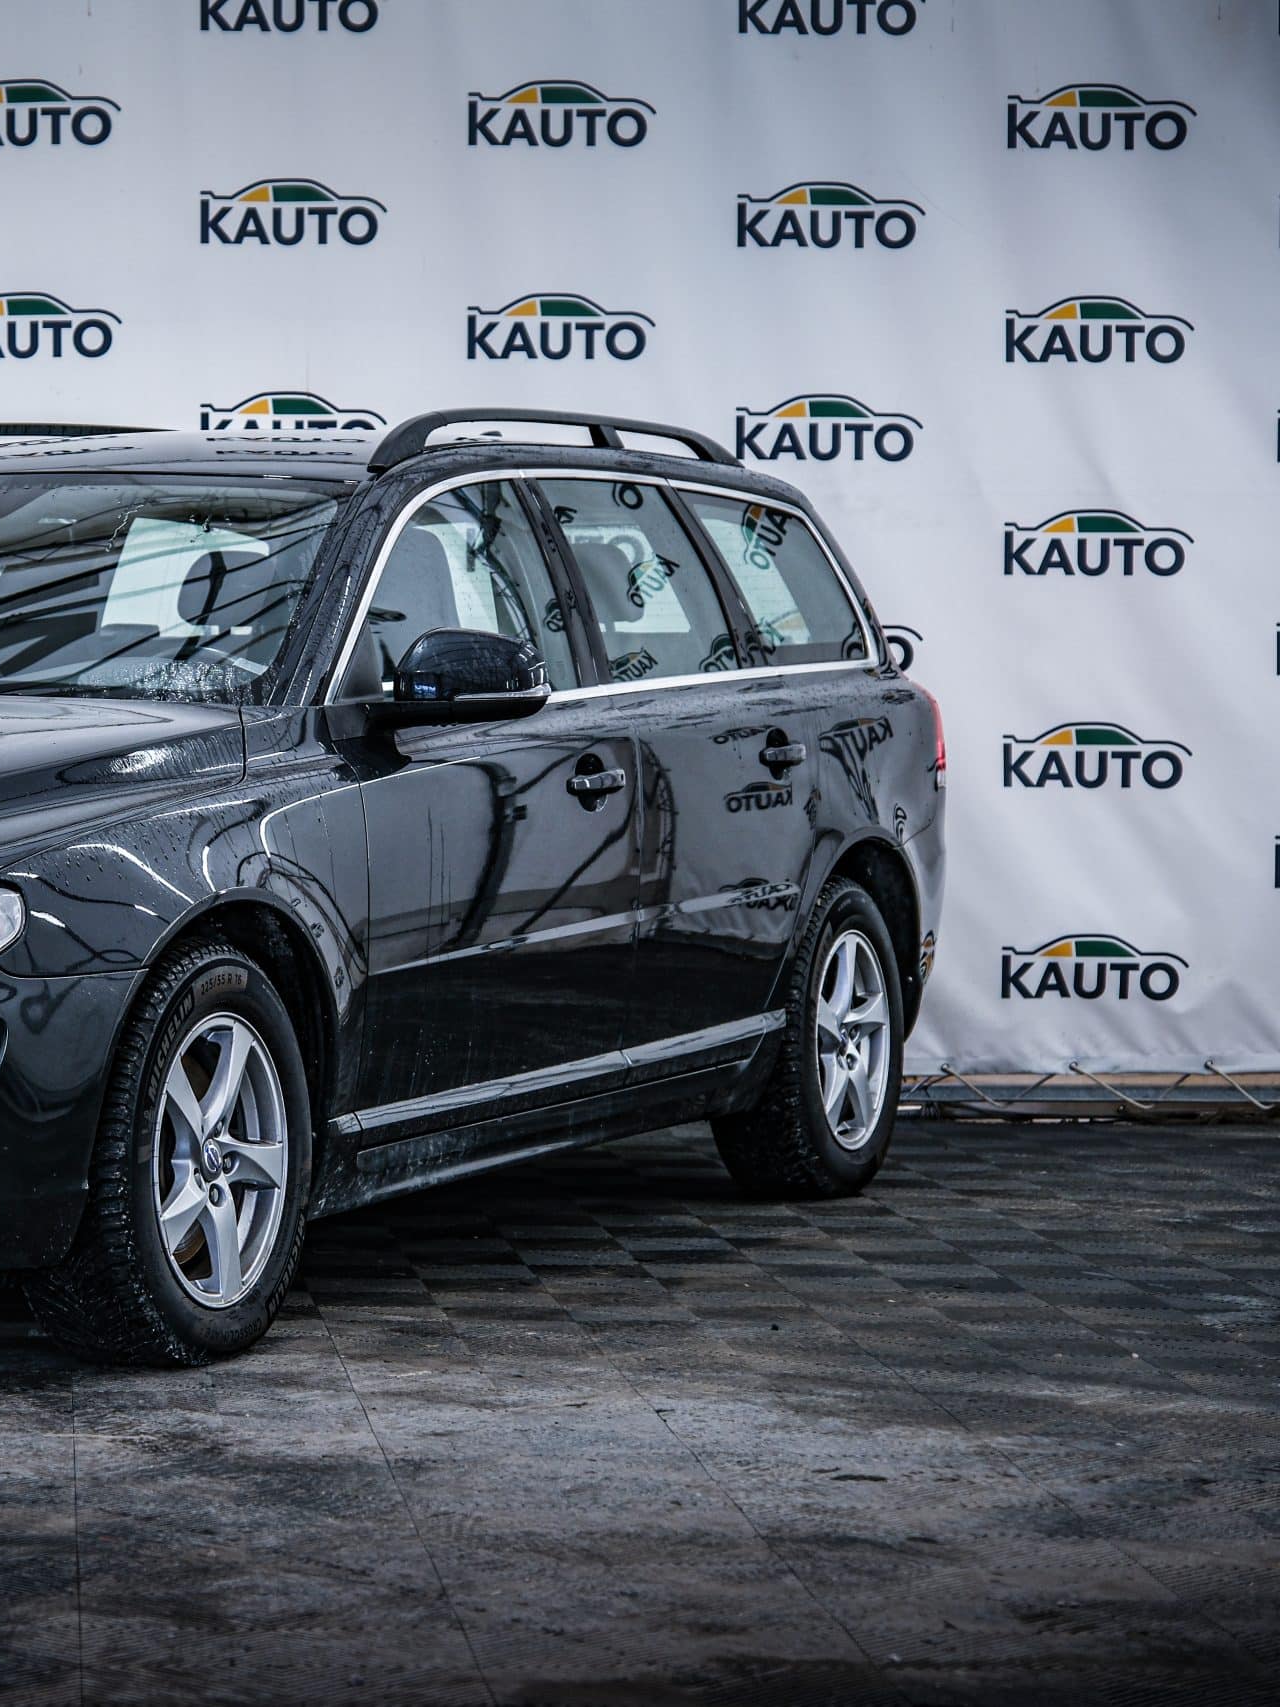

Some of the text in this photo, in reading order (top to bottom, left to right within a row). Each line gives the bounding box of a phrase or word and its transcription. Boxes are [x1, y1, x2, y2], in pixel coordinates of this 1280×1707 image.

[200, 0, 378, 32] KAUTO
[739, 0, 916, 35] KAUTO
[468, 102, 647, 147] KAUTO
[1008, 105, 1187, 150] KAUTO
[201, 201, 377, 245] KAUTO
[737, 204, 916, 249] KAUTO
[468, 316, 645, 360] KAUTO
[1006, 318, 1185, 363] KAUTO
[736, 417, 913, 461] KAUTO
[1005, 532, 1184, 576] KAUTO
[1003, 744, 1182, 789] KAUTO
[1001, 956, 1179, 1000] KAUTO
[147, 992, 194, 1103] MICHELIN
